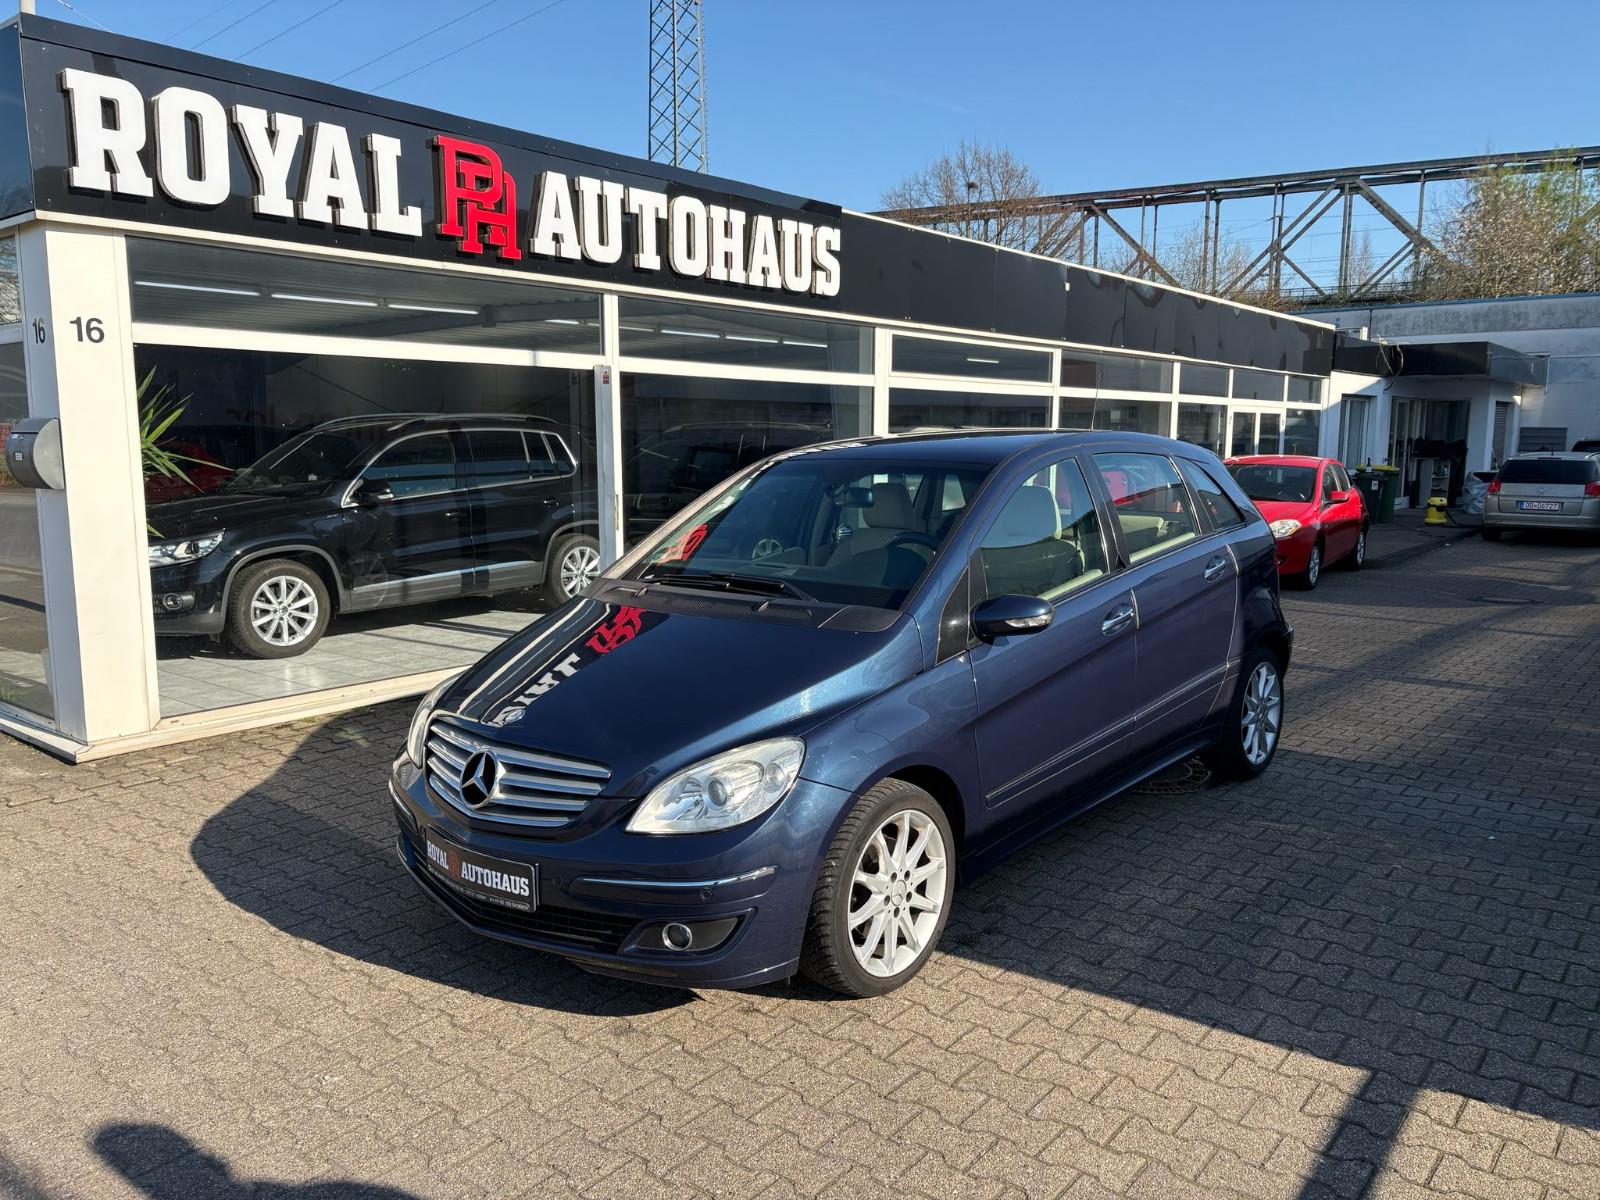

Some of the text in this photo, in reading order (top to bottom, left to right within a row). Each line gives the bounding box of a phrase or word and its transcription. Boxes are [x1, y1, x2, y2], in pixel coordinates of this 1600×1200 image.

[60, 67, 422, 237] ROYAL
[530, 170, 841, 297] AUTOHAUS
[33, 318, 46, 344] 16
[69, 316, 105, 343] 16
[426, 840, 449, 870] ROYAL
[461, 861, 530, 897] AUTOHAUS
